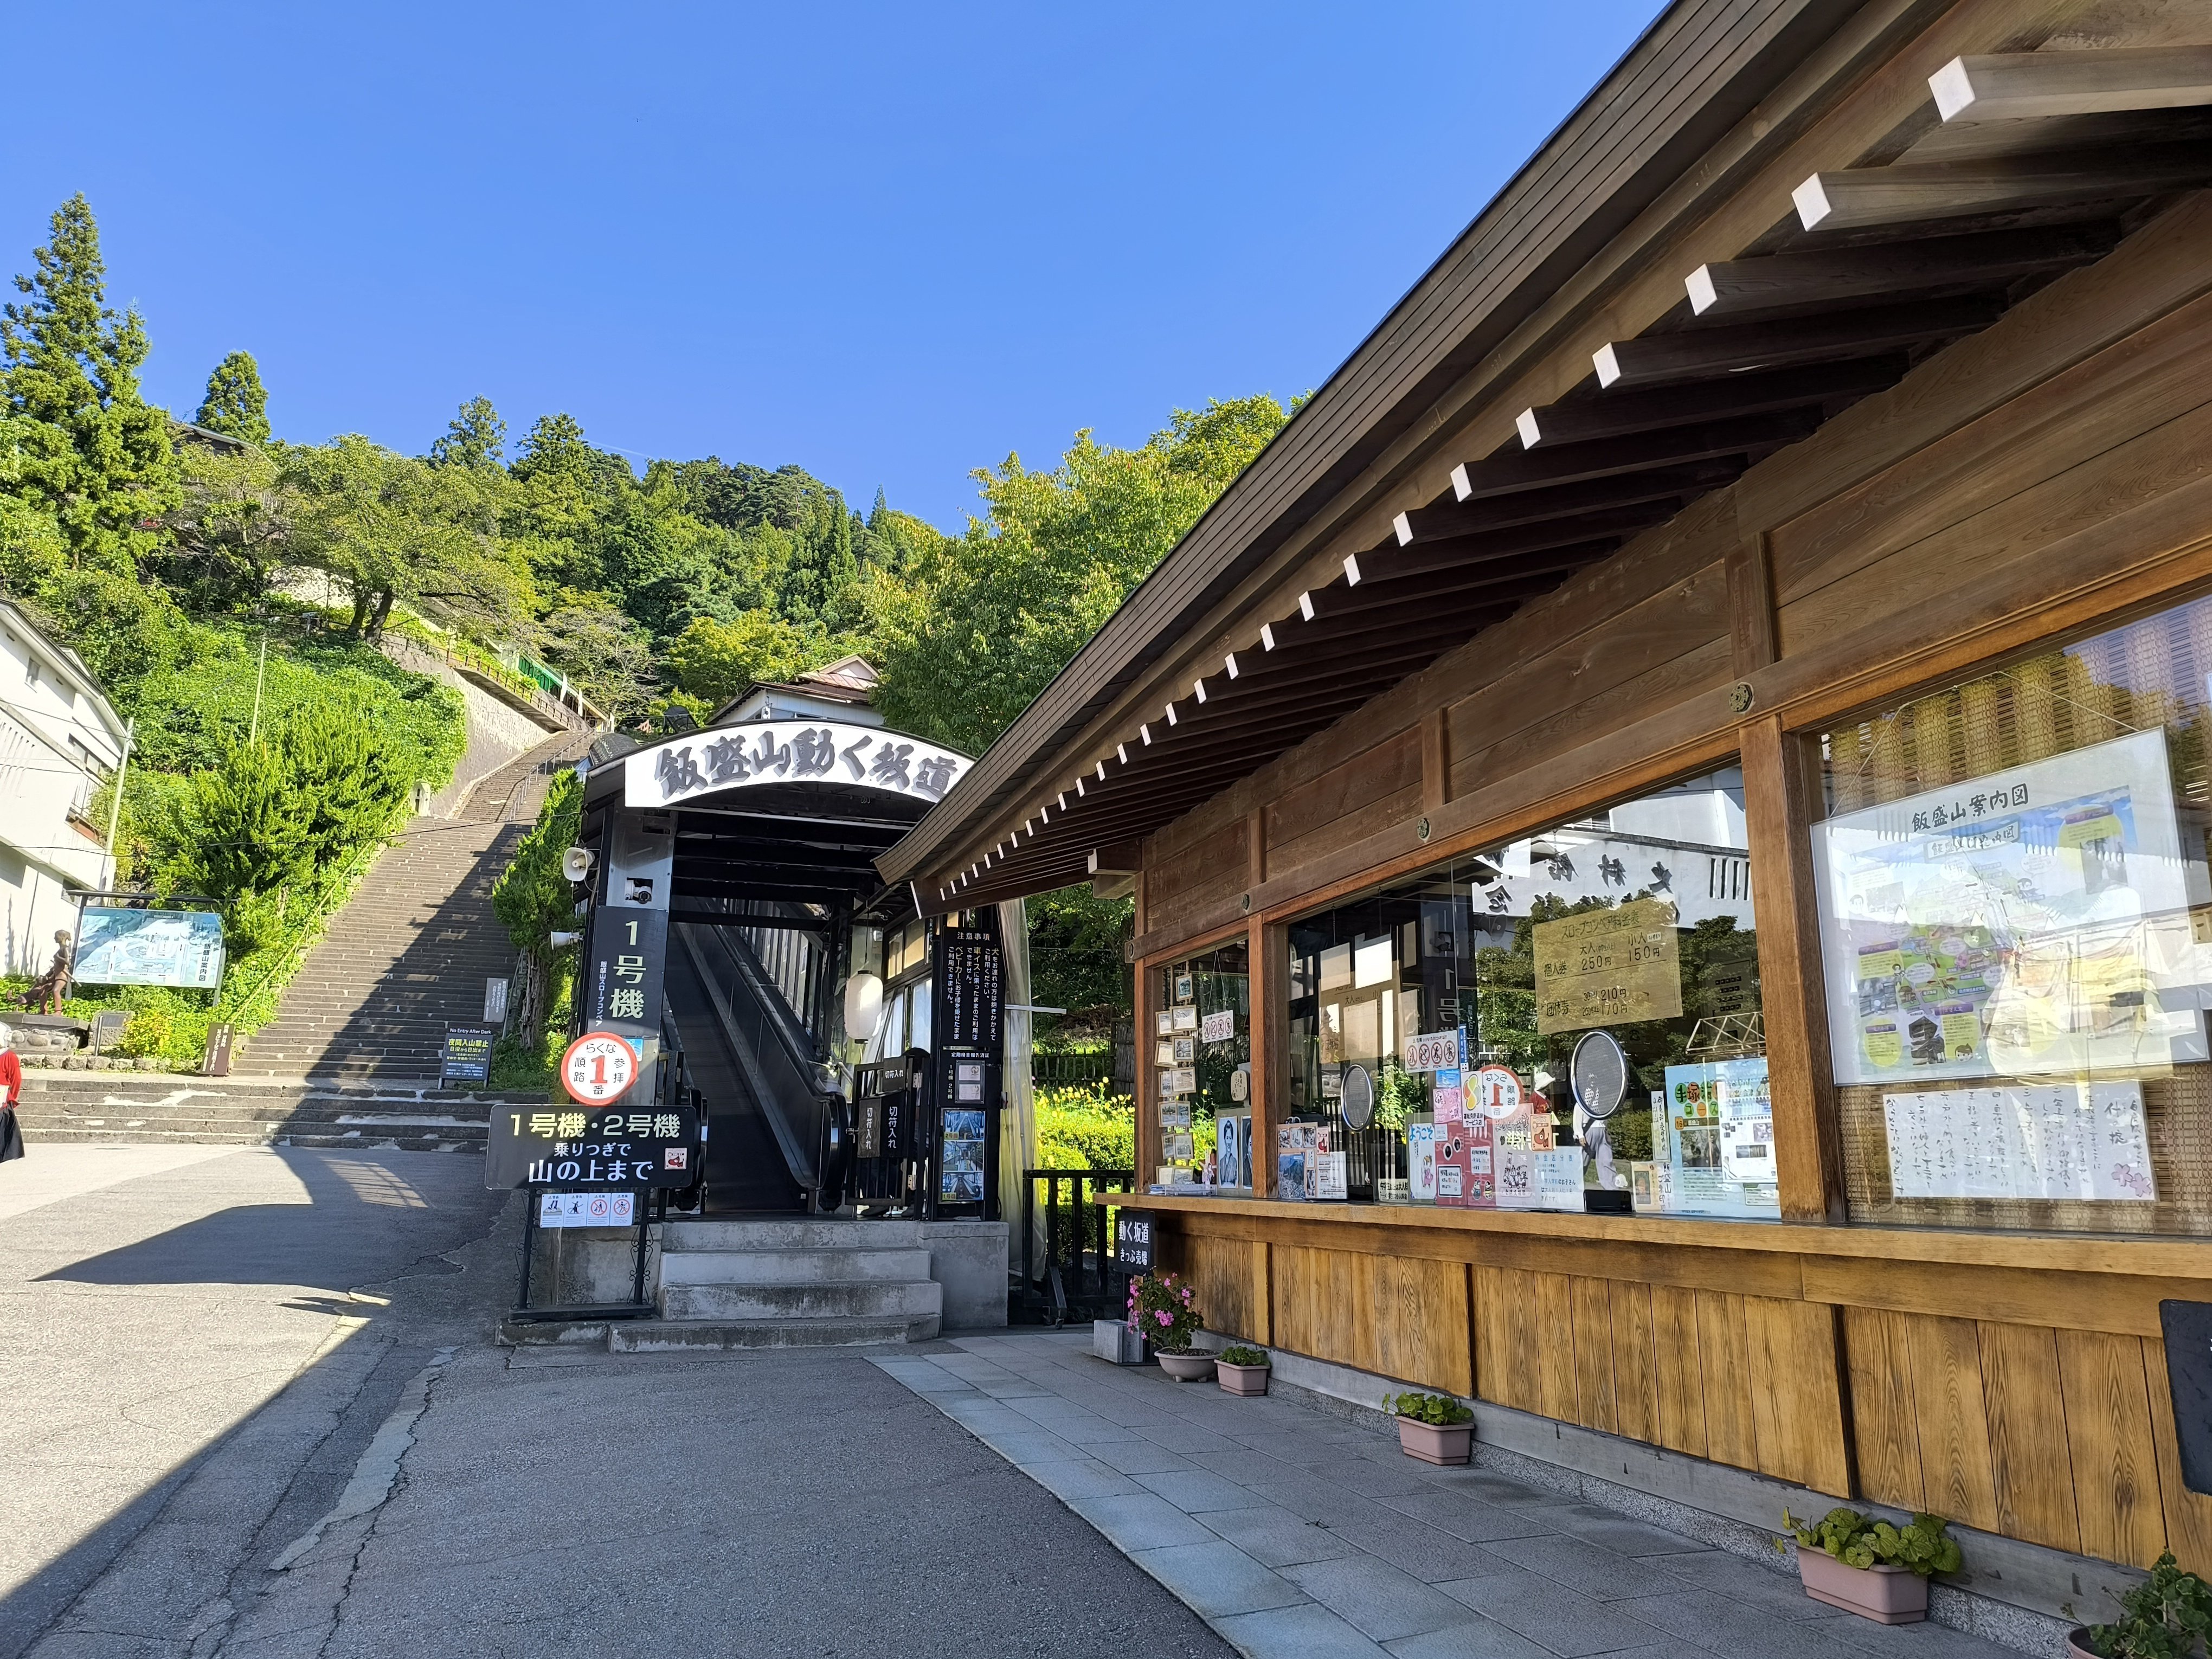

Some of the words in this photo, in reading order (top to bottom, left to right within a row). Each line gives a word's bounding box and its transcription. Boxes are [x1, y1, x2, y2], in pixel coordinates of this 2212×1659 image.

[654, 729, 956, 800] 飯盛山動く坂道
[1912, 783, 2028, 832] 飯盛山案内図
[1561, 910, 1639, 940] スロープコンベア料金表
[957, 932, 990, 941] 注意事項
[1628, 932, 1646, 946] 小人
[1580, 942, 1596, 955] 大人
[1629, 946, 1660, 962] 150円
[609, 921, 646, 1018] 1号機
[1544, 961, 1567, 976] 個人券
[1581, 956, 1612, 970] 250円
[596, 961, 607, 1026] 飯盛山スロープコンベア
[1601, 988, 1626, 1001] 210円
[1602, 1004, 1627, 1015] 170円
[448, 1038, 488, 1047] 夜間入山禁止
[586, 1044, 616, 1053] らくな
[590, 1055, 608, 1084] 1
[1686, 1103, 1718, 1115] コース
[510, 1113, 680, 1138] 1号機・2号機
[888, 1107, 898, 1149] 切符入れ
[1410, 1126, 1434, 1141] ようこそ
[554, 1142, 631, 1157] 乗りつぎで
[529, 1159, 653, 1182] 山の上まで
[1118, 1220, 1149, 1244] 動く坂道
[1120, 1248, 1147, 1266] きっぷ売場
